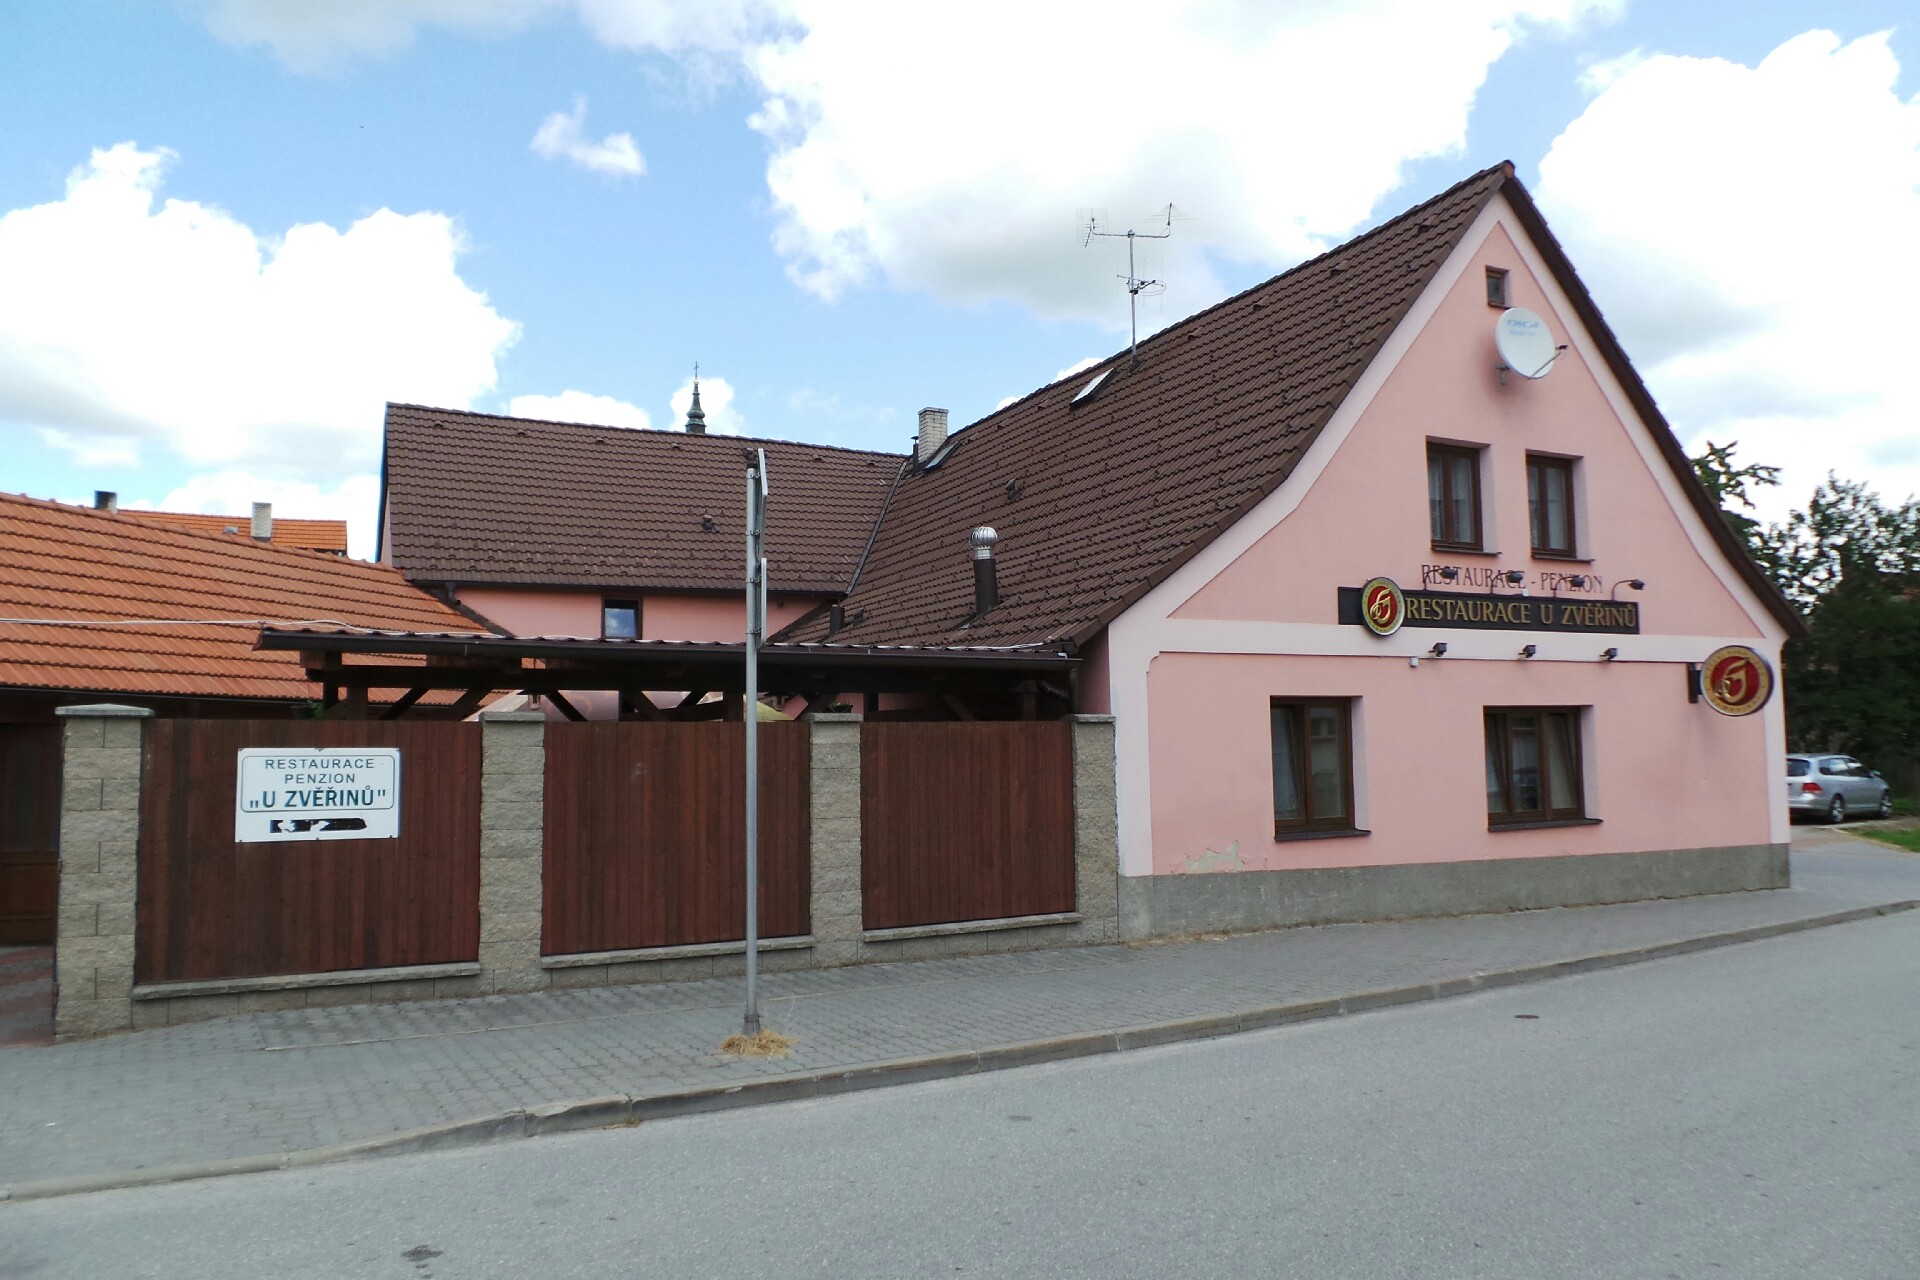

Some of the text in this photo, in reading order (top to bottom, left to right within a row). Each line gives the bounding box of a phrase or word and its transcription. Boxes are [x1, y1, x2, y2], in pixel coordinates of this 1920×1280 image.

[1540, 572, 1604, 593] PENZON
[1405, 597, 1531, 624] RESTAURACE
[1540, 604, 1554, 625] U
[1561, 602, 1636, 628] ZVĚŘINŮ
[265, 758, 375, 769] RESTAURACE
[284, 773, 355, 784] PENZION
